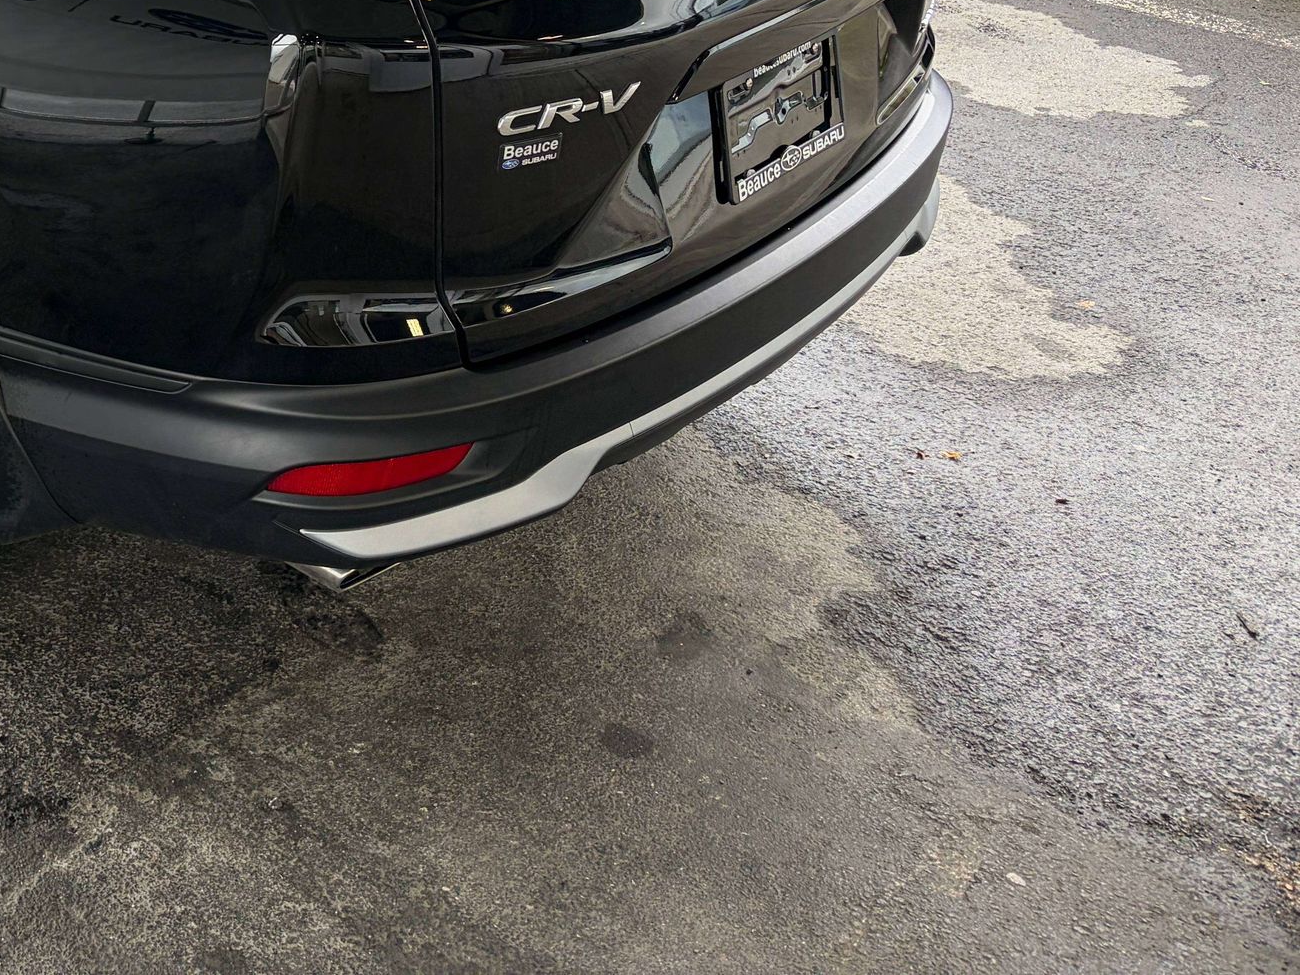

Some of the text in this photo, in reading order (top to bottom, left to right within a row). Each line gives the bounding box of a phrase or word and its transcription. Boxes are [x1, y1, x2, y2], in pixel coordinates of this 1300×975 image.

[497, 81, 642, 136] CR-V
[503, 139, 559, 160] Beauce
[521, 152, 557, 166] SUBARU
[737, 125, 845, 202] Beauce SUBARU
